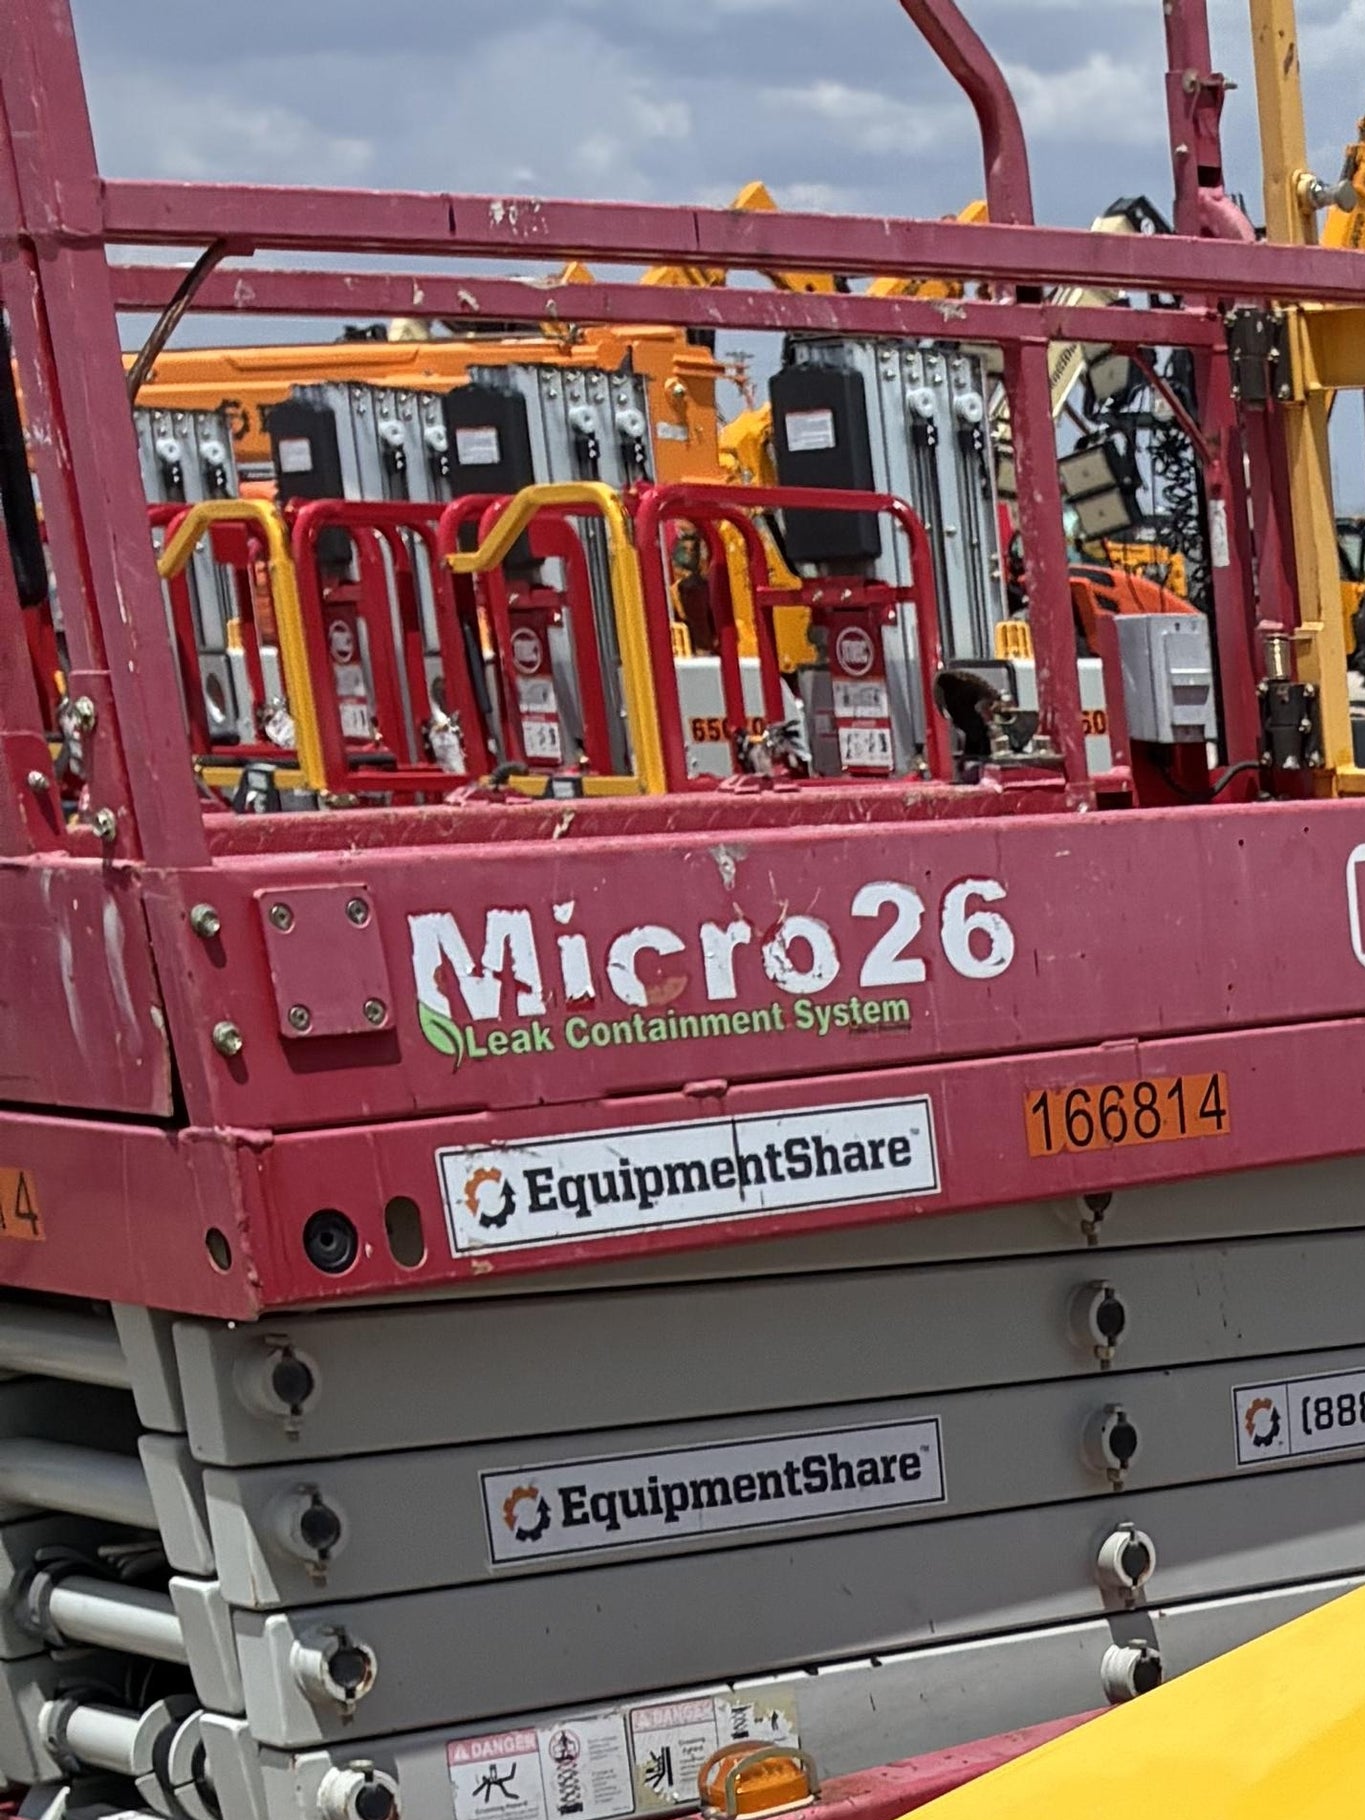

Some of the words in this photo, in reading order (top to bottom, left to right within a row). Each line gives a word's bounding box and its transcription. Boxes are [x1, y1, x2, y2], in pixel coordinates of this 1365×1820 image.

[409, 876, 1016, 1020] Micro26
[464, 1021, 554, 1059] Leak
[564, 1005, 784, 1050] Containment
[793, 996, 911, 1037] System
[1031, 1071, 1227, 1154] 166814
